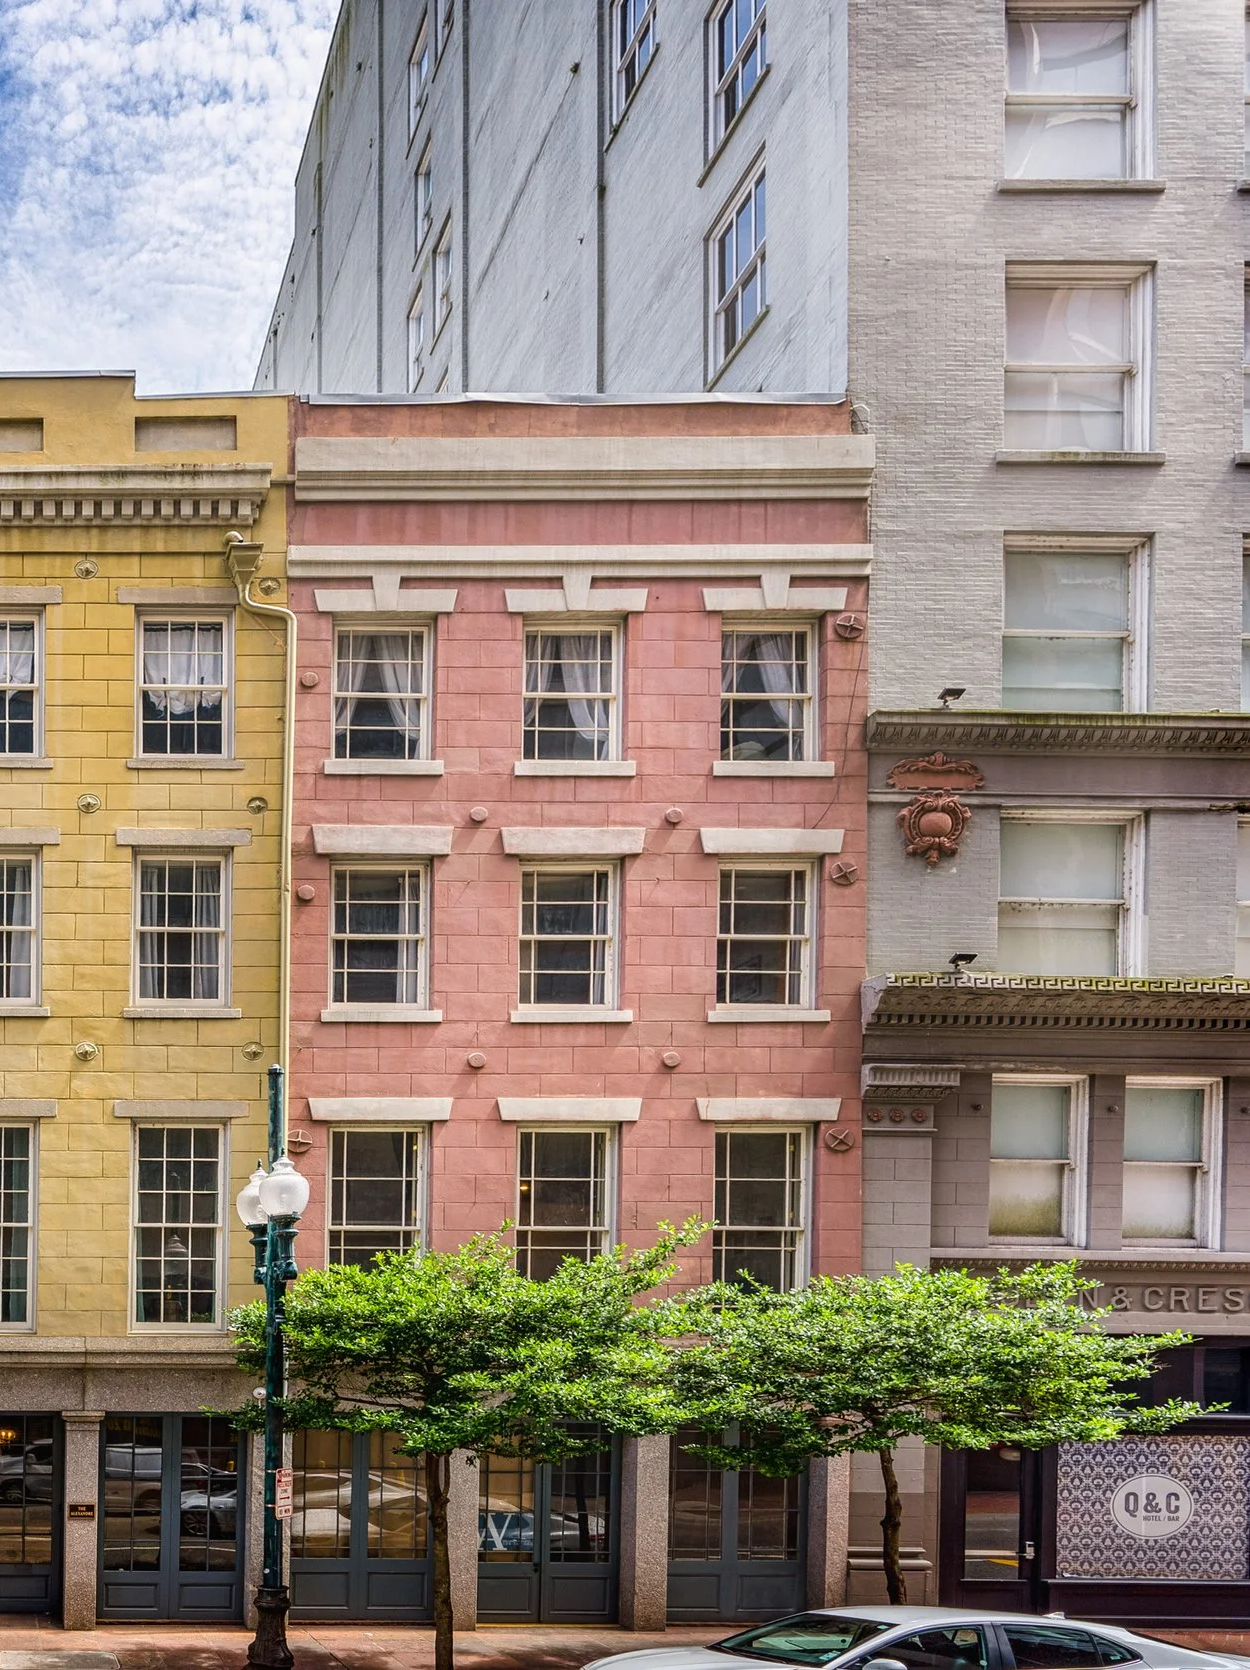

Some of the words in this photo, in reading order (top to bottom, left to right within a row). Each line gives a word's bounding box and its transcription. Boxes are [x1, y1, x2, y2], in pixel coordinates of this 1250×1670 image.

[1111, 1286, 1133, 1310] &
[1124, 1492, 1139, 1518] Q
[1143, 1492, 1162, 1514] &
[1165, 1492, 1180, 1514] C
